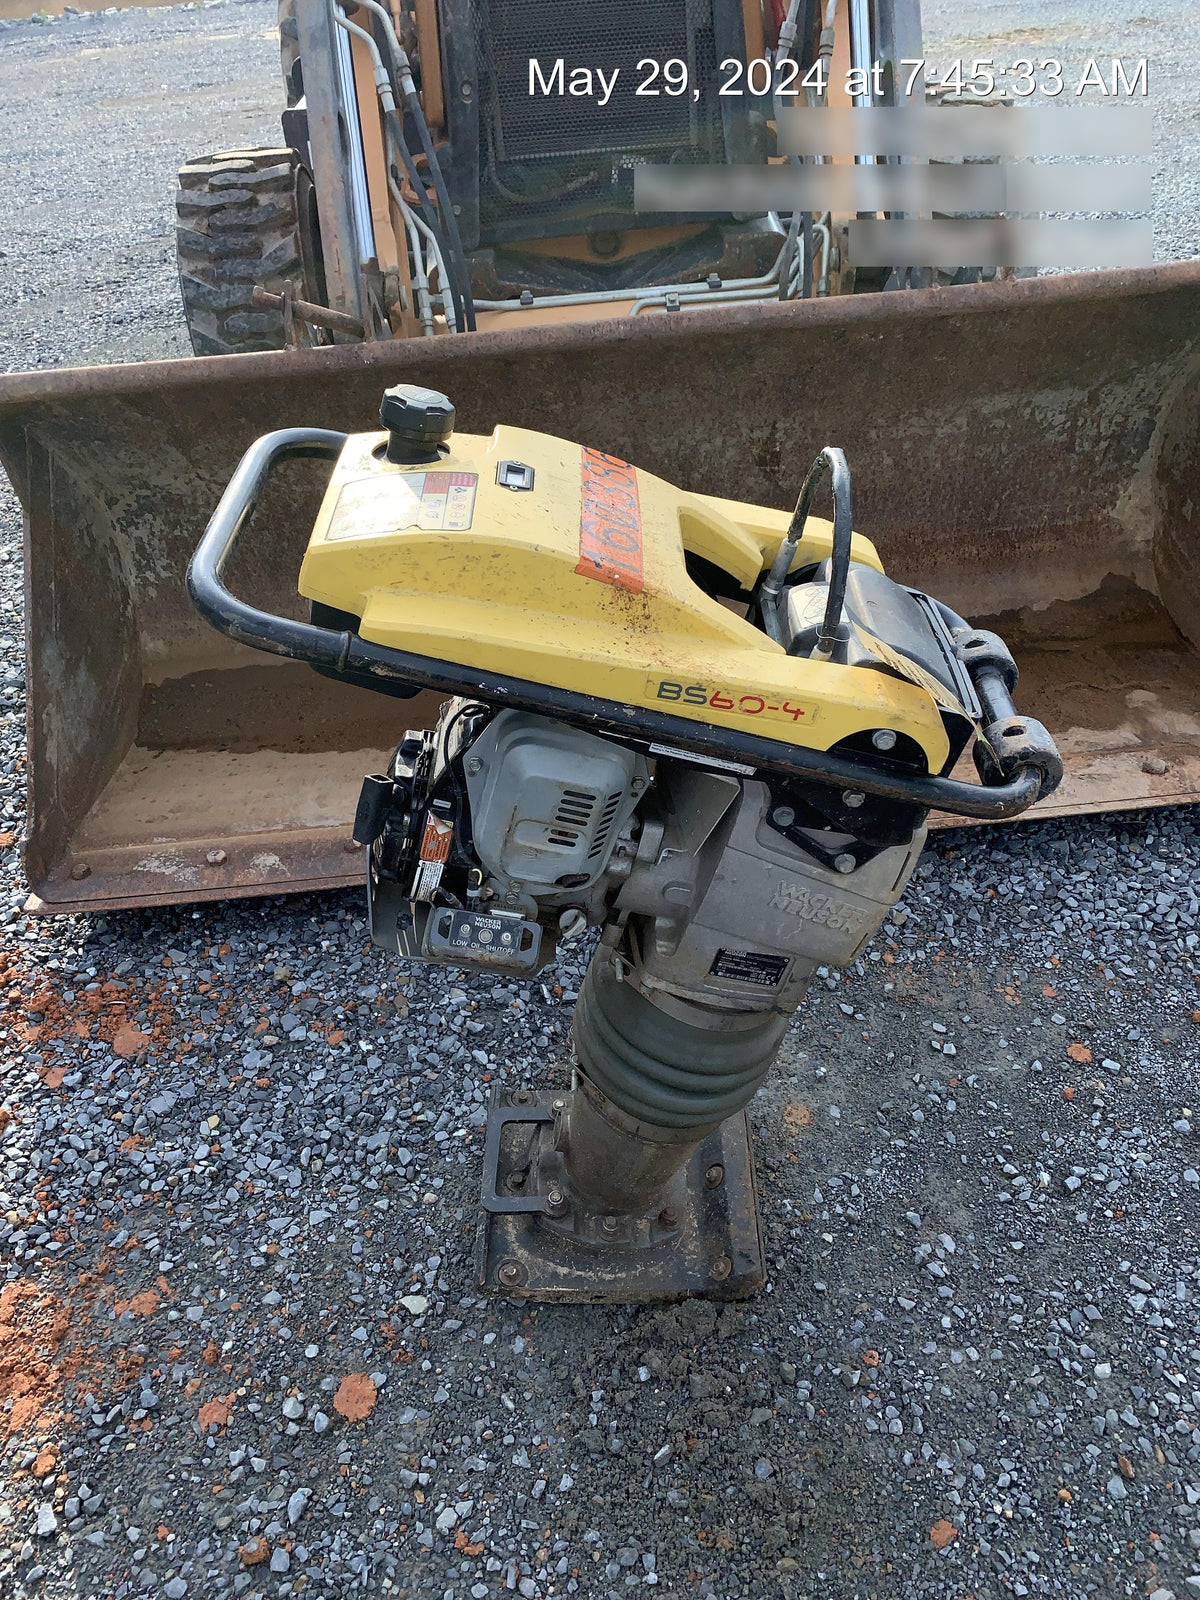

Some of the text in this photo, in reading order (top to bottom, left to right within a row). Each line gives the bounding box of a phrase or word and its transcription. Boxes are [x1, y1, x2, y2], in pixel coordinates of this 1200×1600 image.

[656, 681, 805, 721] BS60-4
[779, 880, 868, 918] WACKER
[474, 921, 502, 930] NEUSON
[475, 916, 502, 925] WACKER
[767, 893, 863, 933] NEUSON
[452, 939, 469, 947] LOW
[486, 945, 516, 954] SHUTOFF
